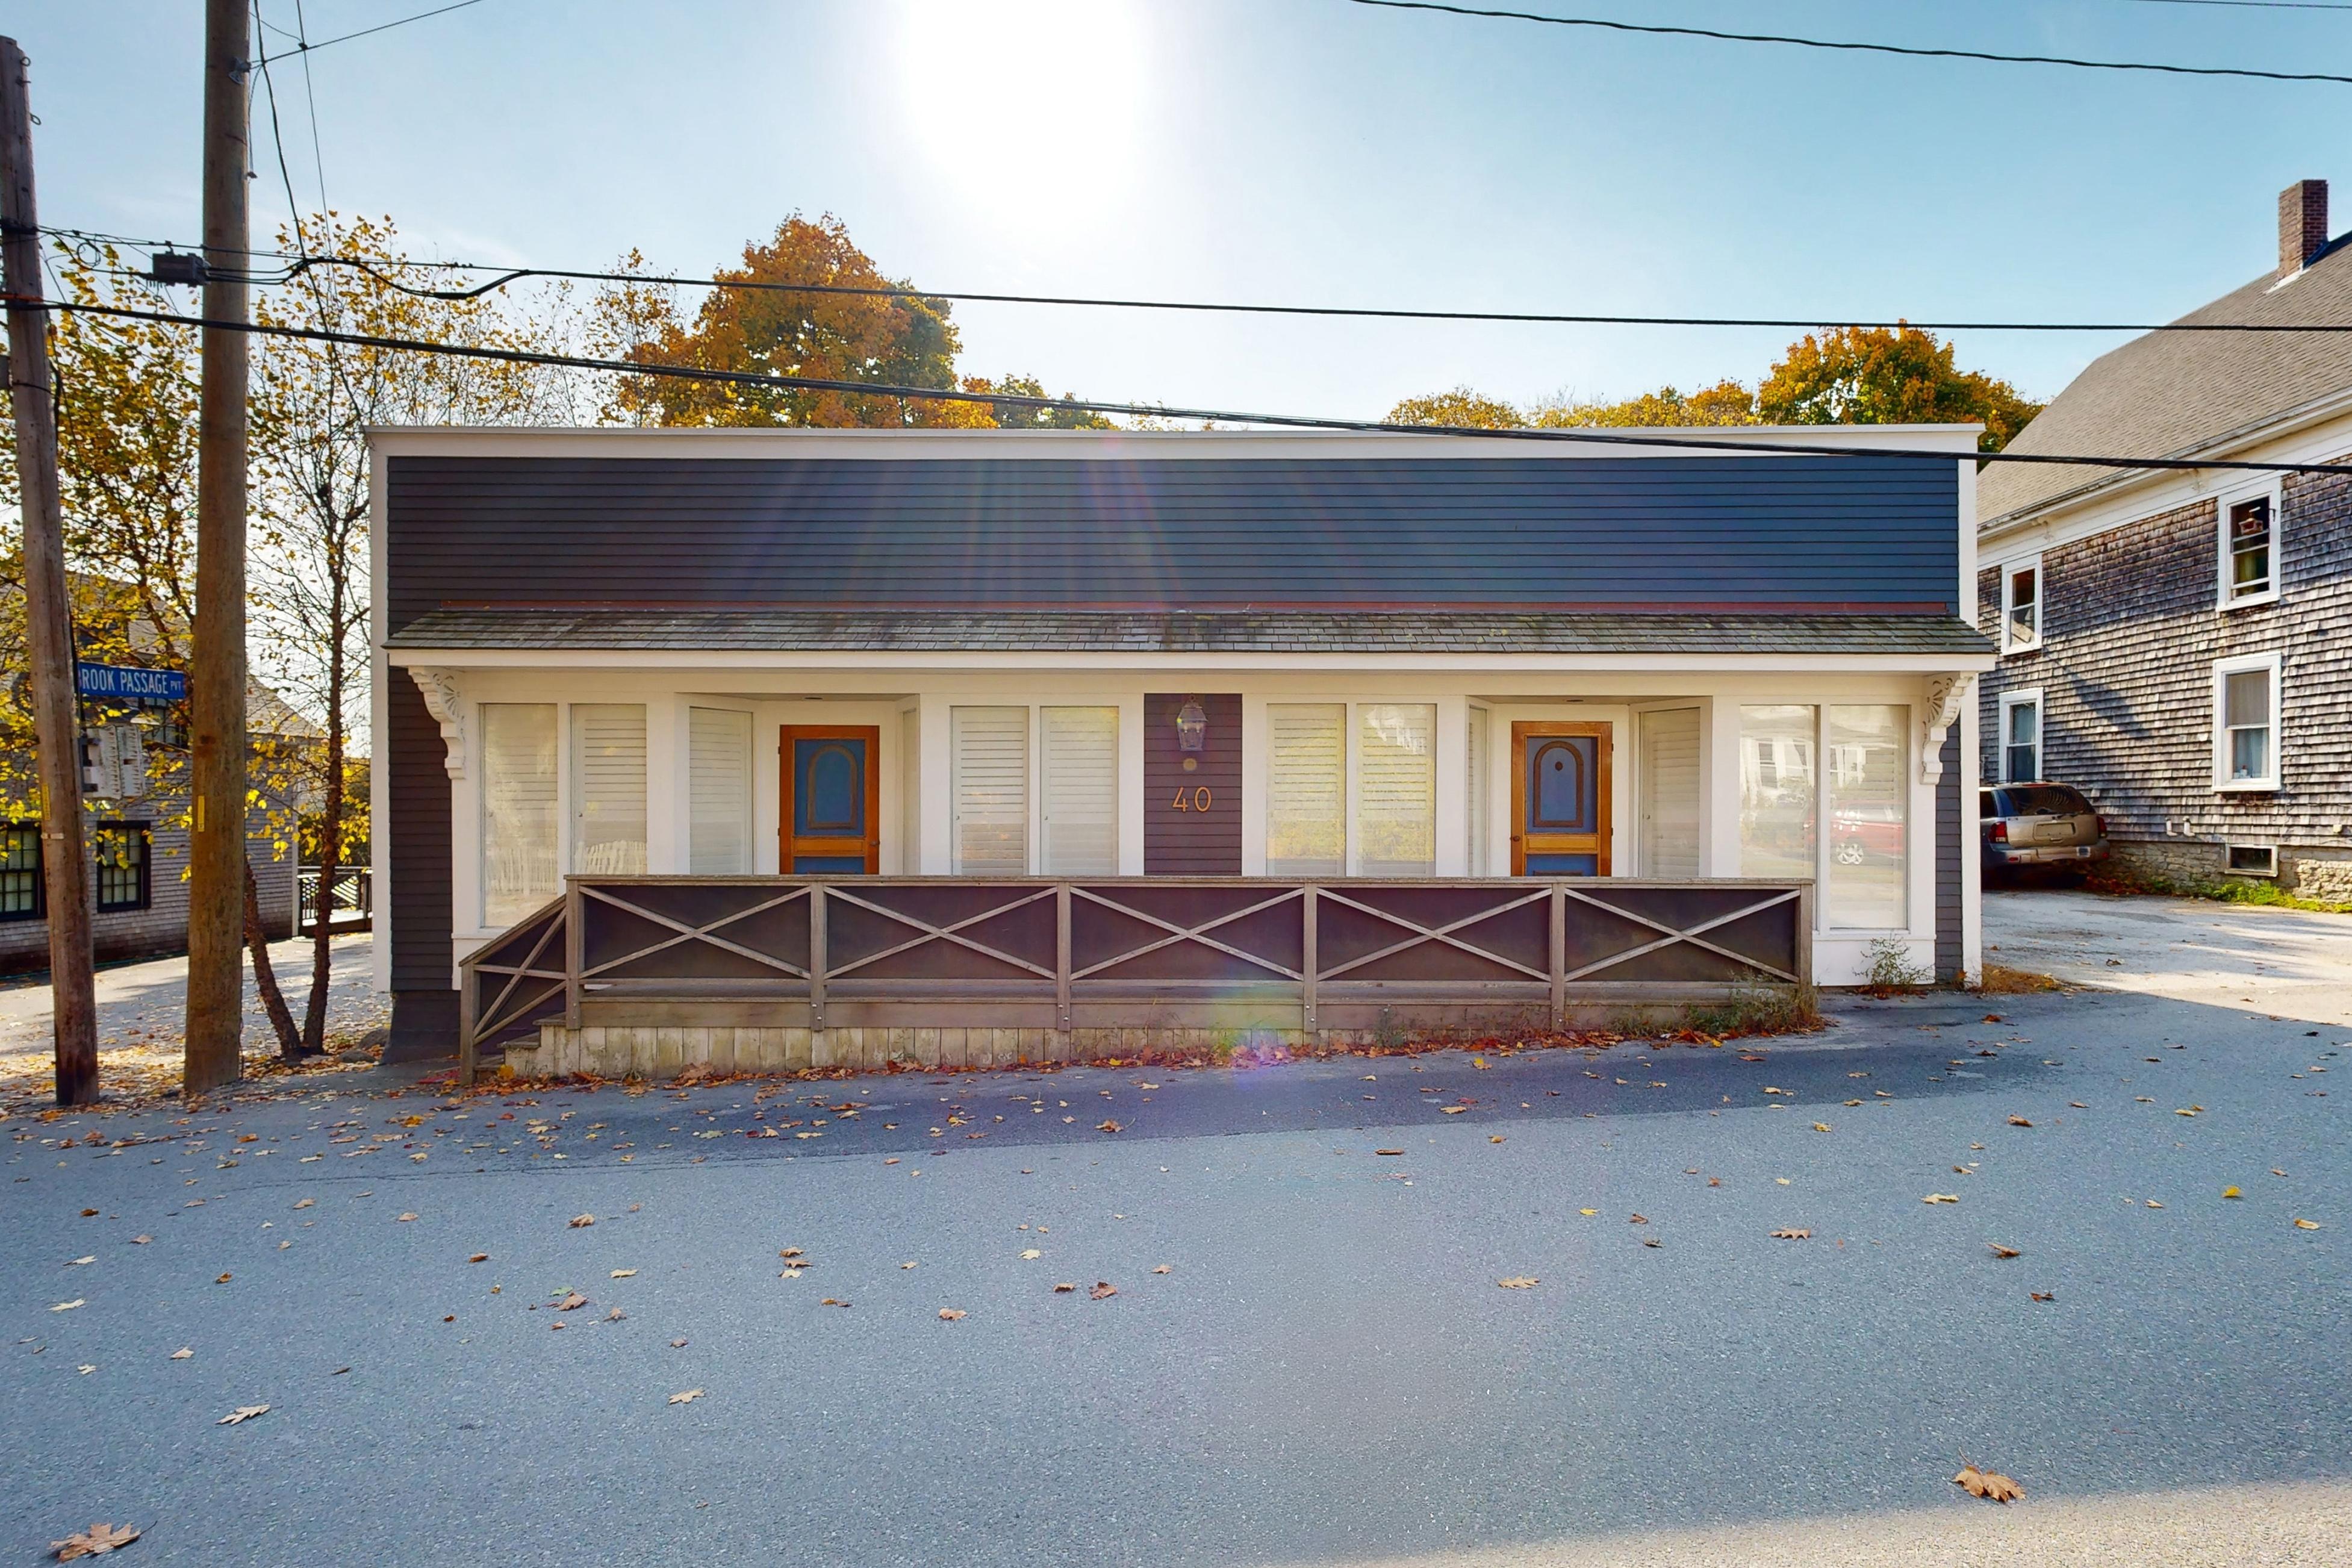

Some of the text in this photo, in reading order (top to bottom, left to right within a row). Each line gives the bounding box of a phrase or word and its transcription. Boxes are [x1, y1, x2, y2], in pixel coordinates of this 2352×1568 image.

[120, 671, 169, 694] PASSAGE
[170, 680, 181, 691] PVT
[1172, 786, 1212, 812] 40
